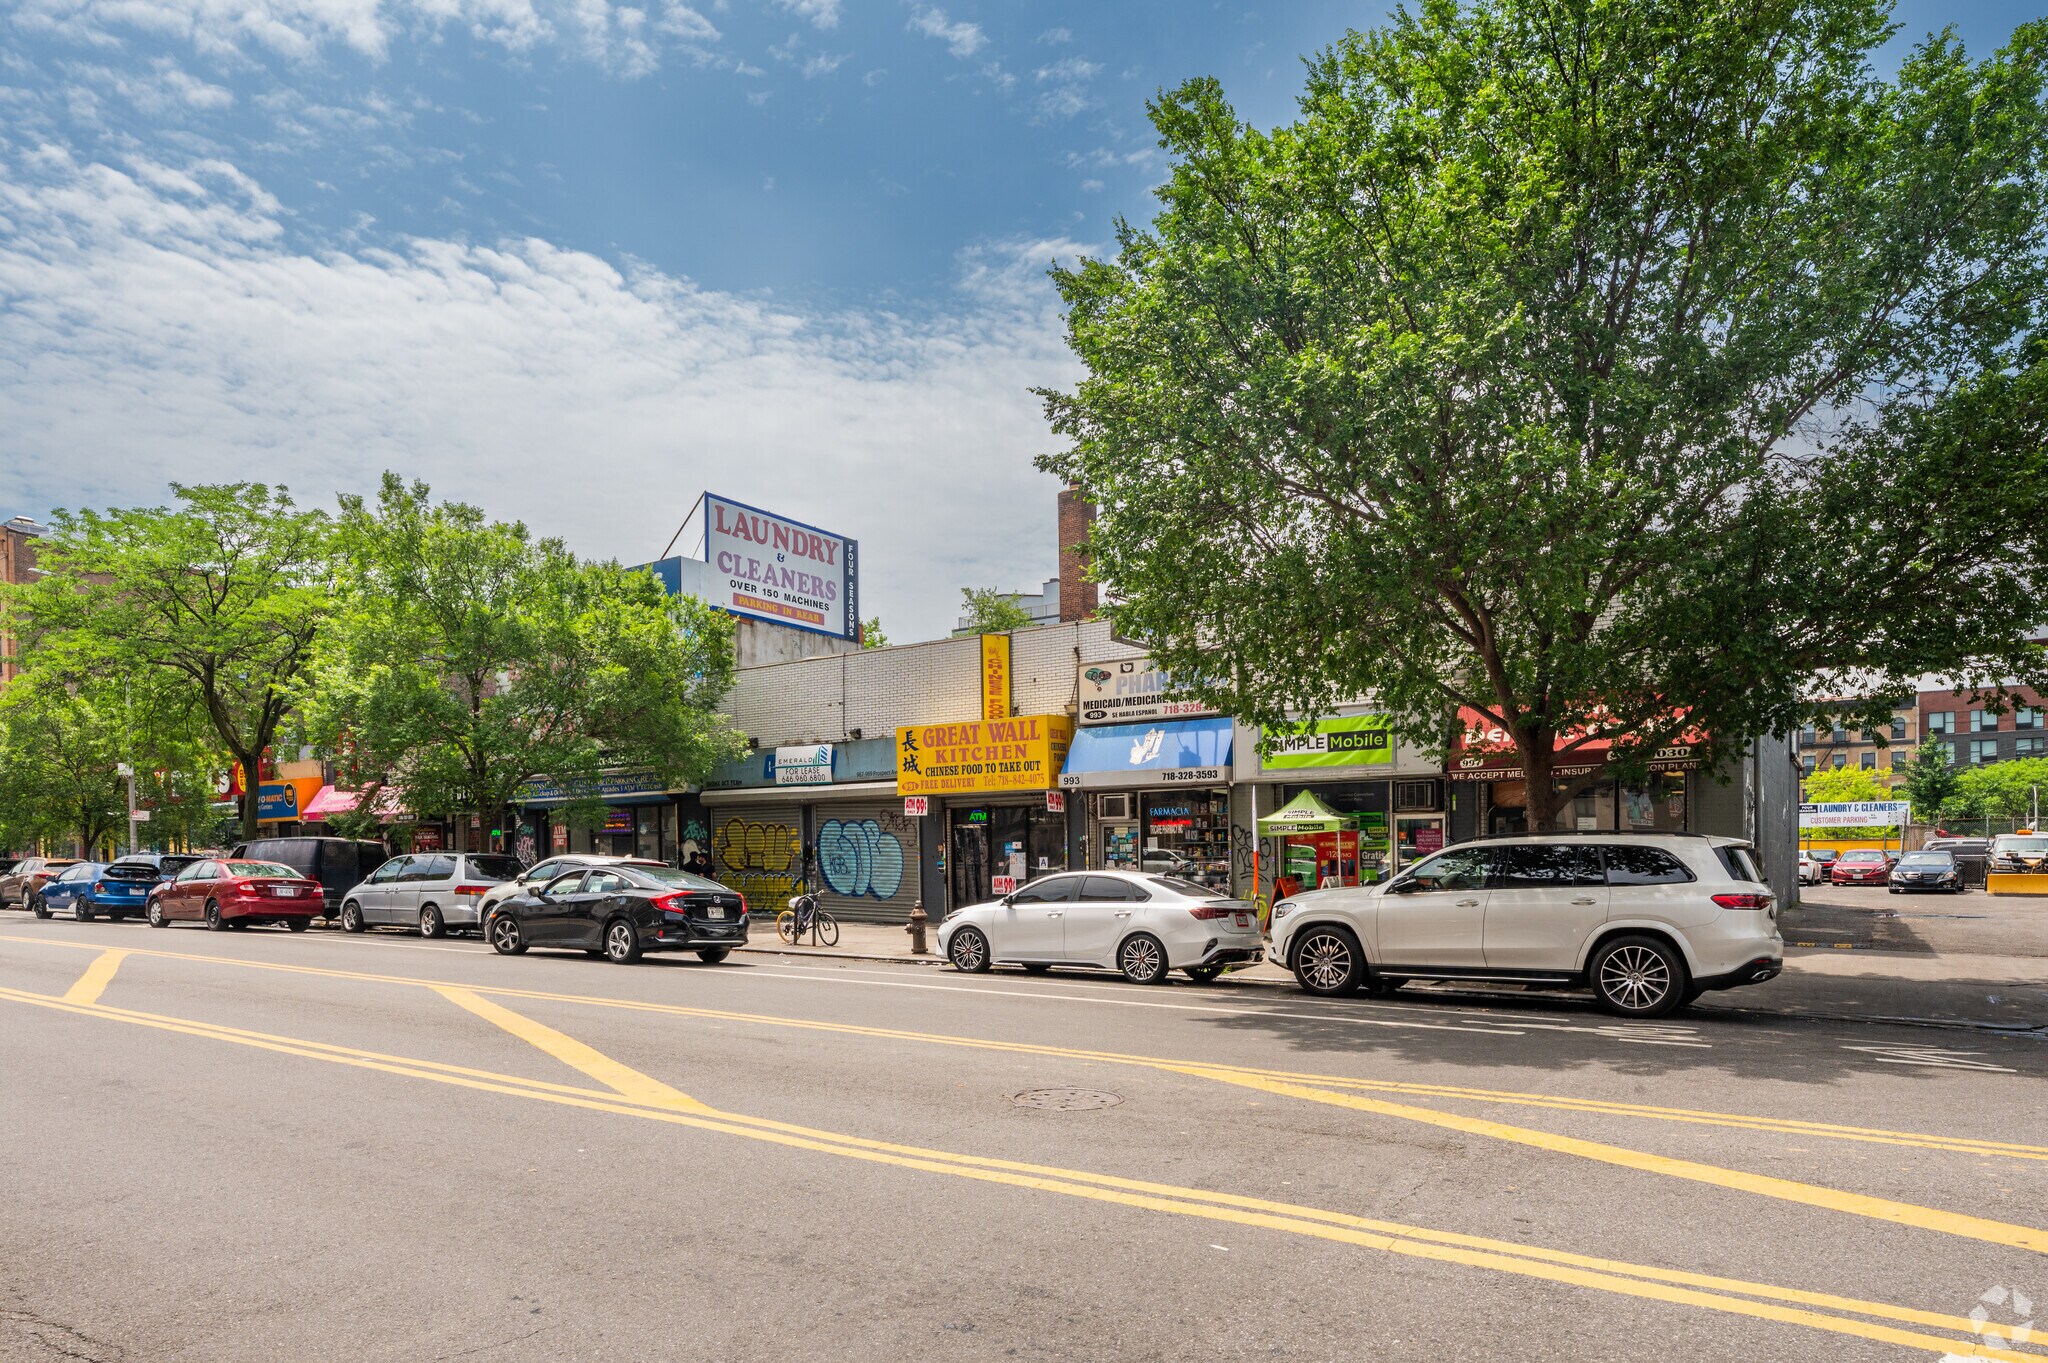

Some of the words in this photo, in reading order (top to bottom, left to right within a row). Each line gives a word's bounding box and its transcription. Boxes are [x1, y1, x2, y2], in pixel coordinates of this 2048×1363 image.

[714, 505, 839, 565] LAUNDRY
[777, 553, 785, 562] &
[717, 551, 837, 602] CLEANERS
[730, 579, 757, 593] OVER
[762, 588, 779, 598] 150
[784, 593, 830, 611] MACHINES
[738, 596, 778, 614] PARKING
[783, 605, 792, 616] IN
[796, 609, 820, 622] REAR
[922, 724, 980, 748] GREAT
[988, 720, 1041, 742] WALL
[1330, 734, 1384, 748] Mobile
[902, 730, 922, 775] 長城
[935, 744, 1028, 764] KITCHEN
[926, 764, 959, 778] CHINESE
[962, 762, 983, 775] FOOD
[986, 762, 996, 774] TO
[999, 761, 1022, 772] TAKE
[1024, 760, 1041, 771] OUT
[1162, 770, 1218, 780] 718-328-3593
[782, 774, 826, 783] 646.960.6800
[1063, 777, 1080, 785] 993
[1467, 772, 1504, 780] ACCEPT
[906, 782, 917, 792] 991
[921, 780, 938, 790] FREE
[941, 778, 976, 788] DELIVERY
[983, 776, 996, 786] Tel:
[998, 774, 1045, 786] 718-842-4075
[1150, 807, 1190, 816] FARMACIA
[1820, 804, 1852, 812] LAUNDRY
[1861, 803, 1898, 812] CLEANERS
[969, 813, 986, 821] ATM
[1362, 850, 1385, 860] Gratis
[1040, 858, 1046, 866] A
